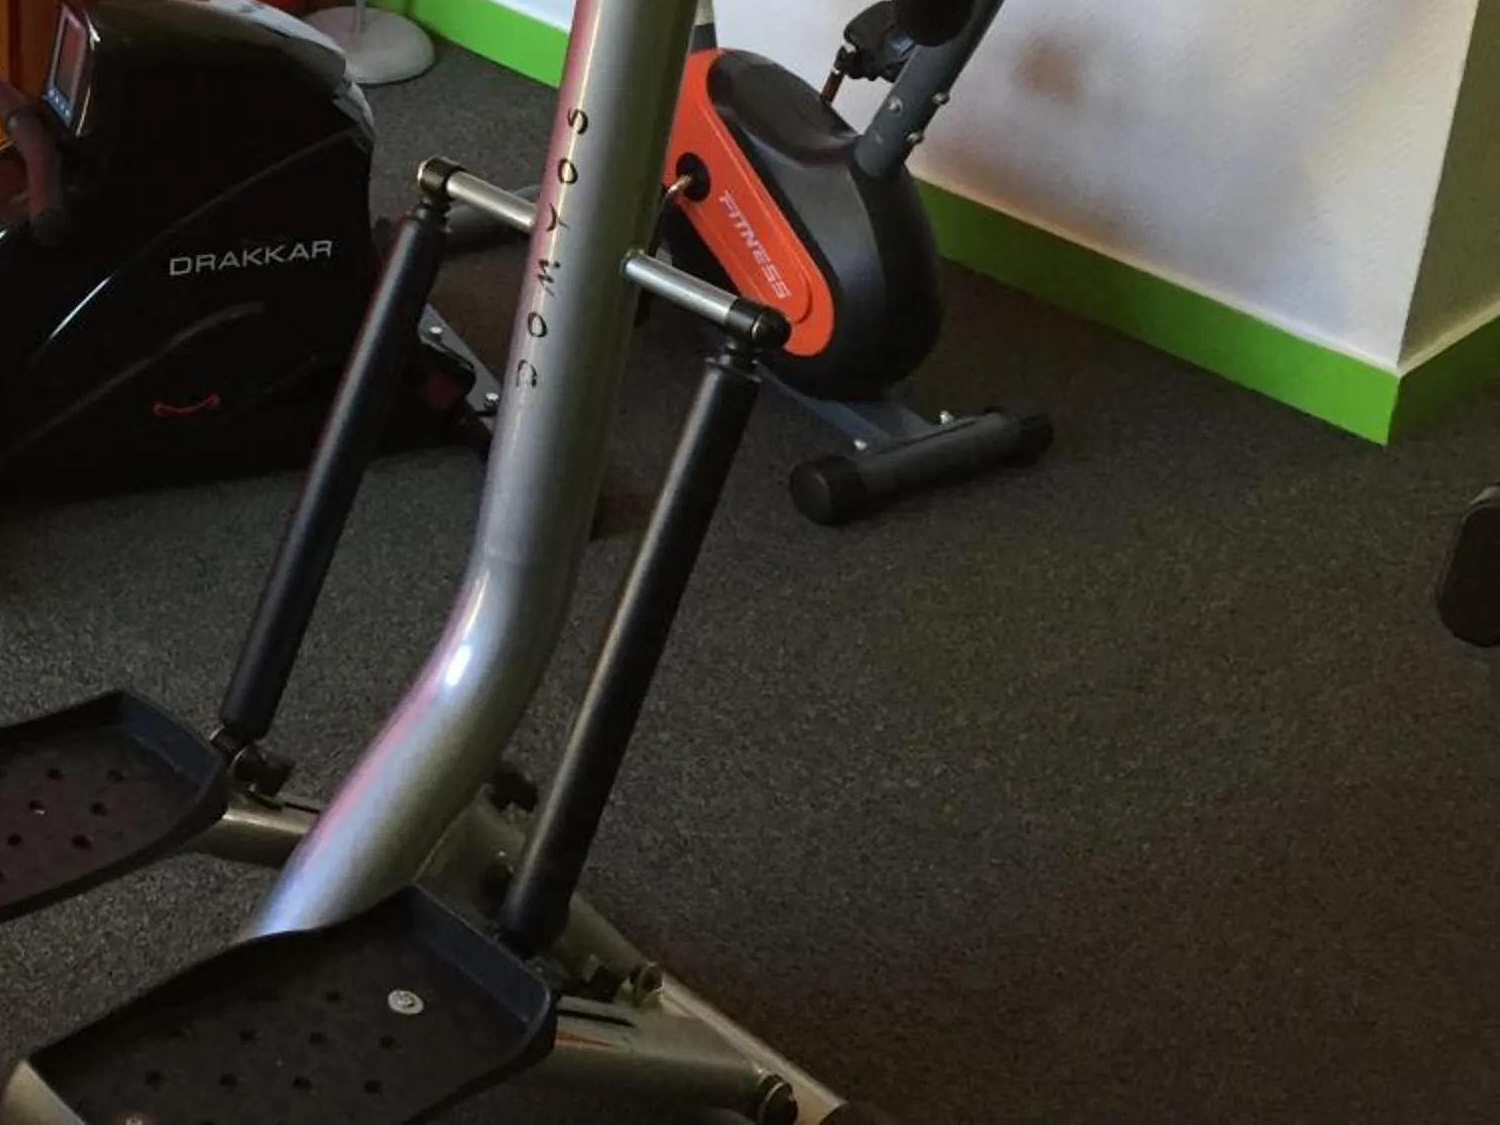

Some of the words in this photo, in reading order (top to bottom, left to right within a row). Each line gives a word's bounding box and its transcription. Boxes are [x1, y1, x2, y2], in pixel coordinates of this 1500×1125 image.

[169, 240, 333, 276] DRAKKAR
[515, 107, 588, 387] DOMYOS
[719, 189, 791, 299] FITNESS
